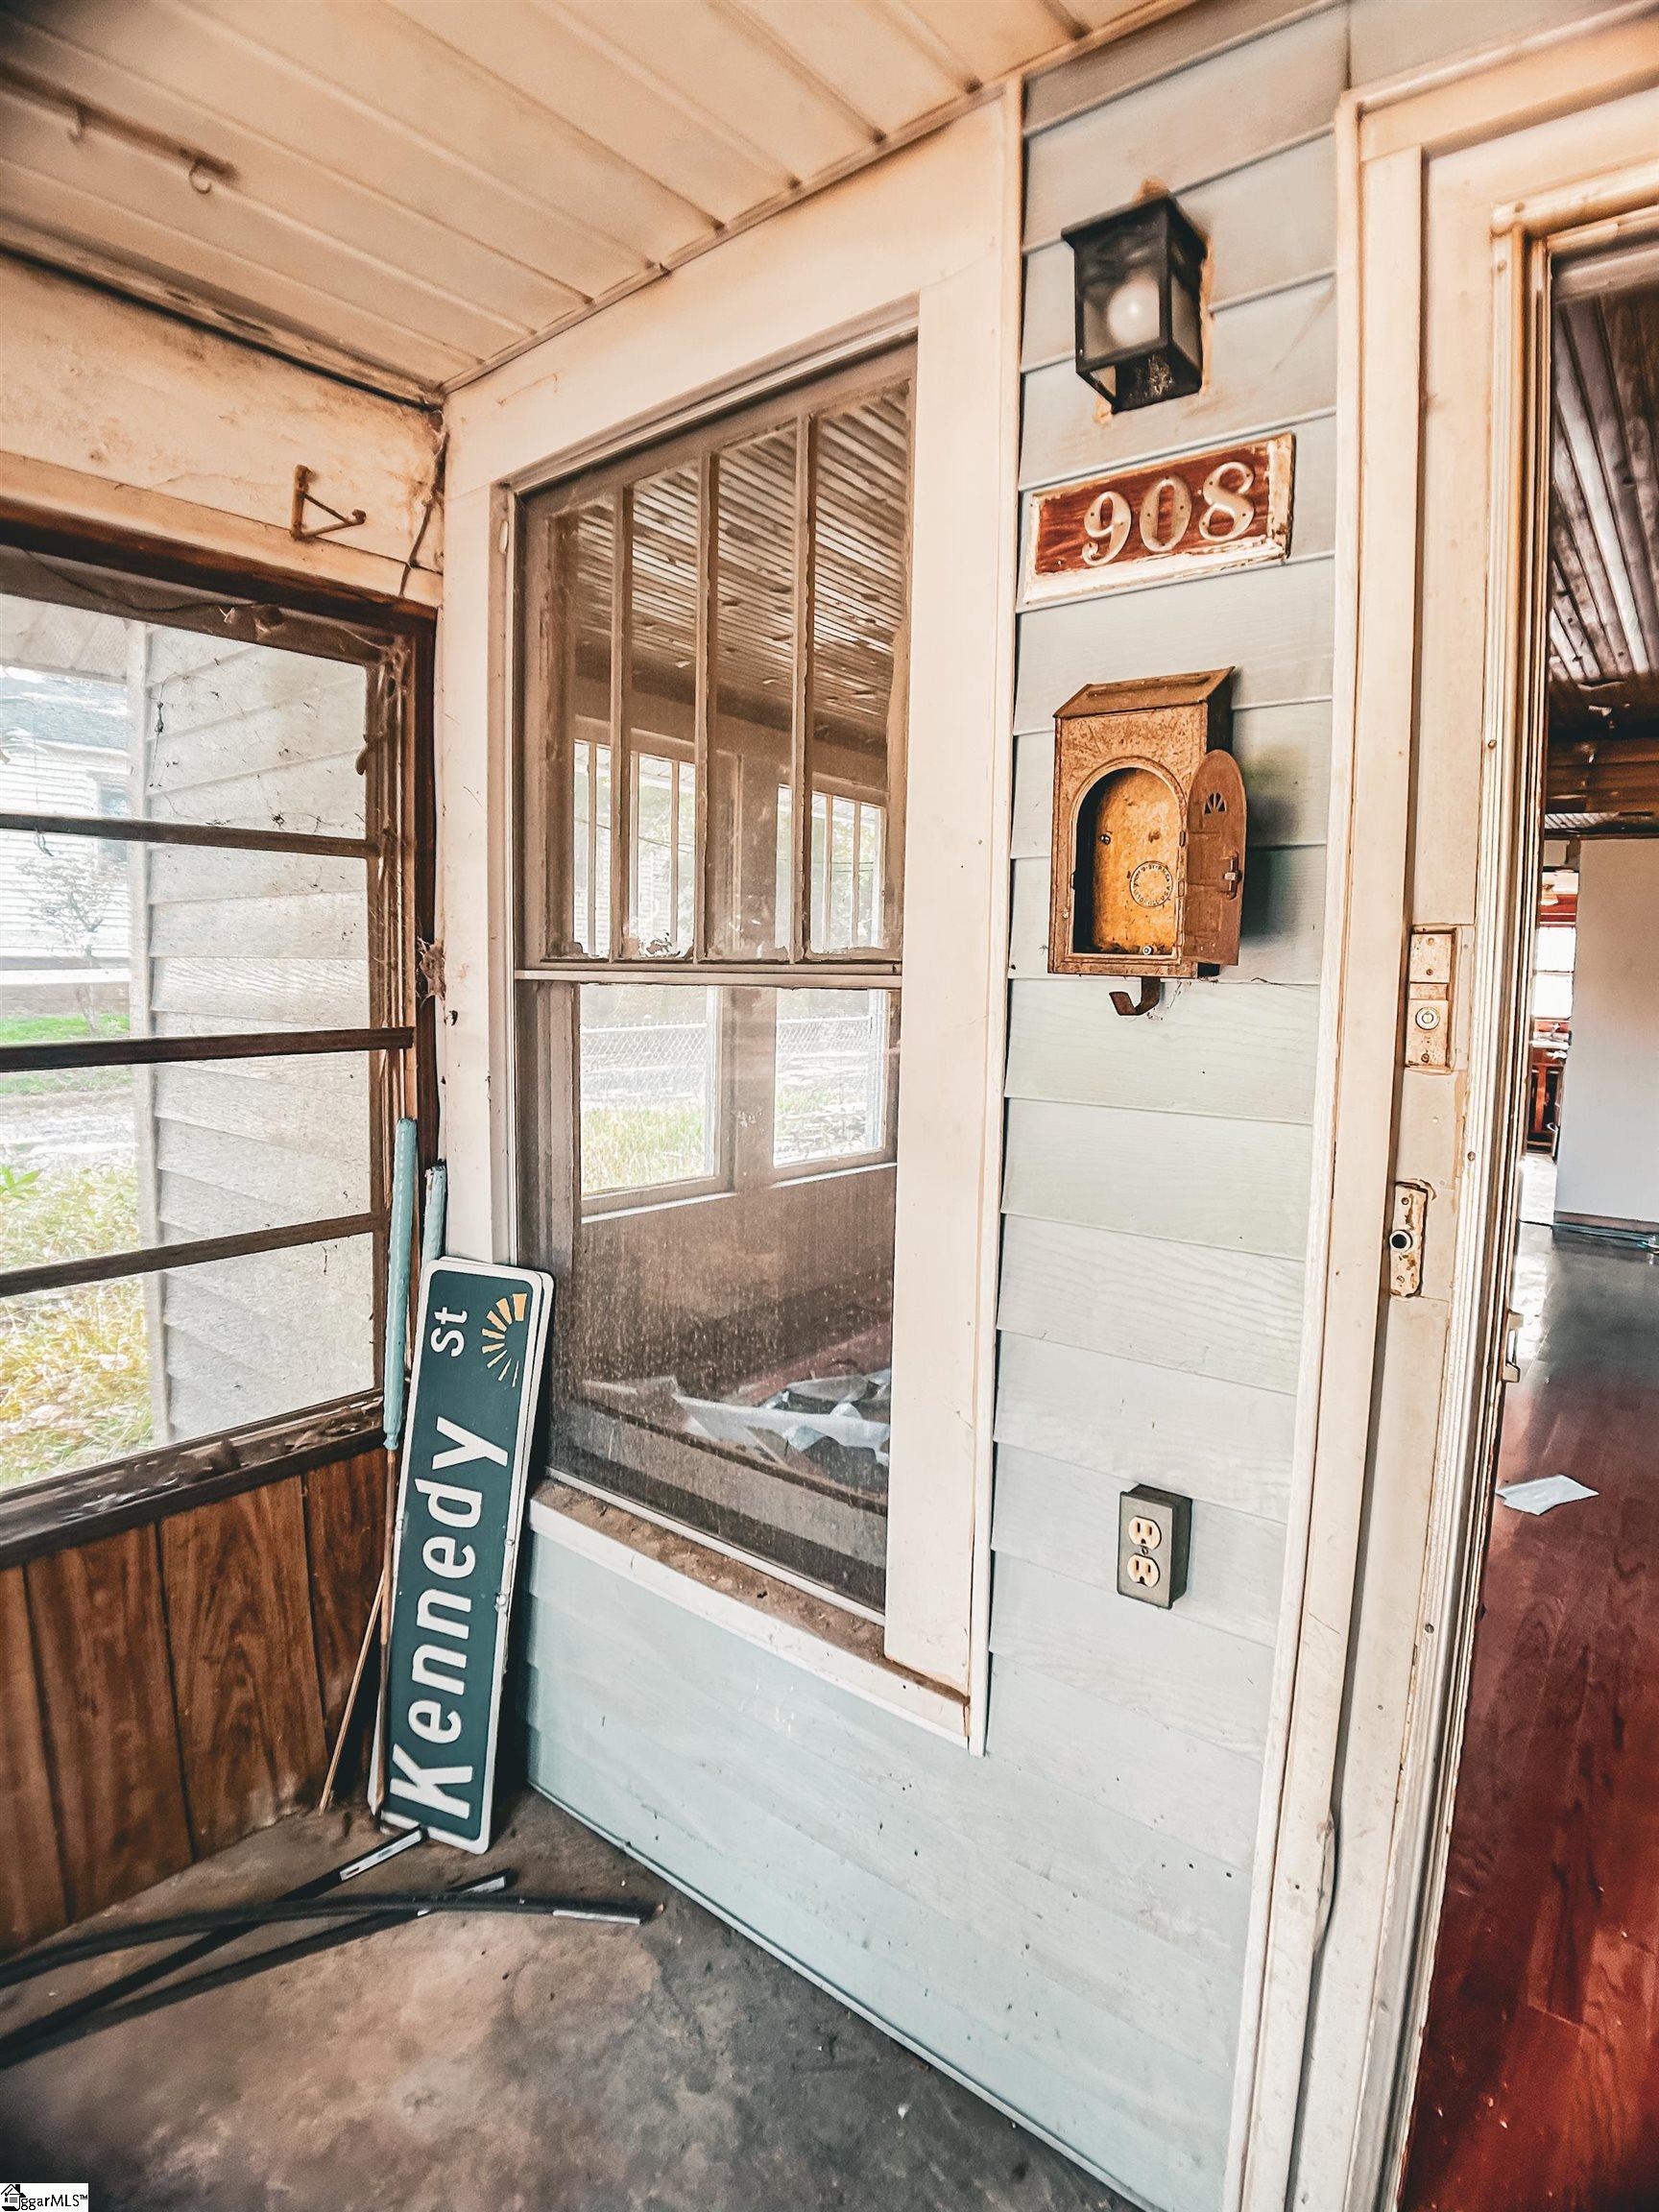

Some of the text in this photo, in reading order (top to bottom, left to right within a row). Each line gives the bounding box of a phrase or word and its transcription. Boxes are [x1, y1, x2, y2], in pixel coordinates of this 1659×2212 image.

[1081, 461, 1255, 566] 908
[389, 1307, 509, 1819] Kennedy St
